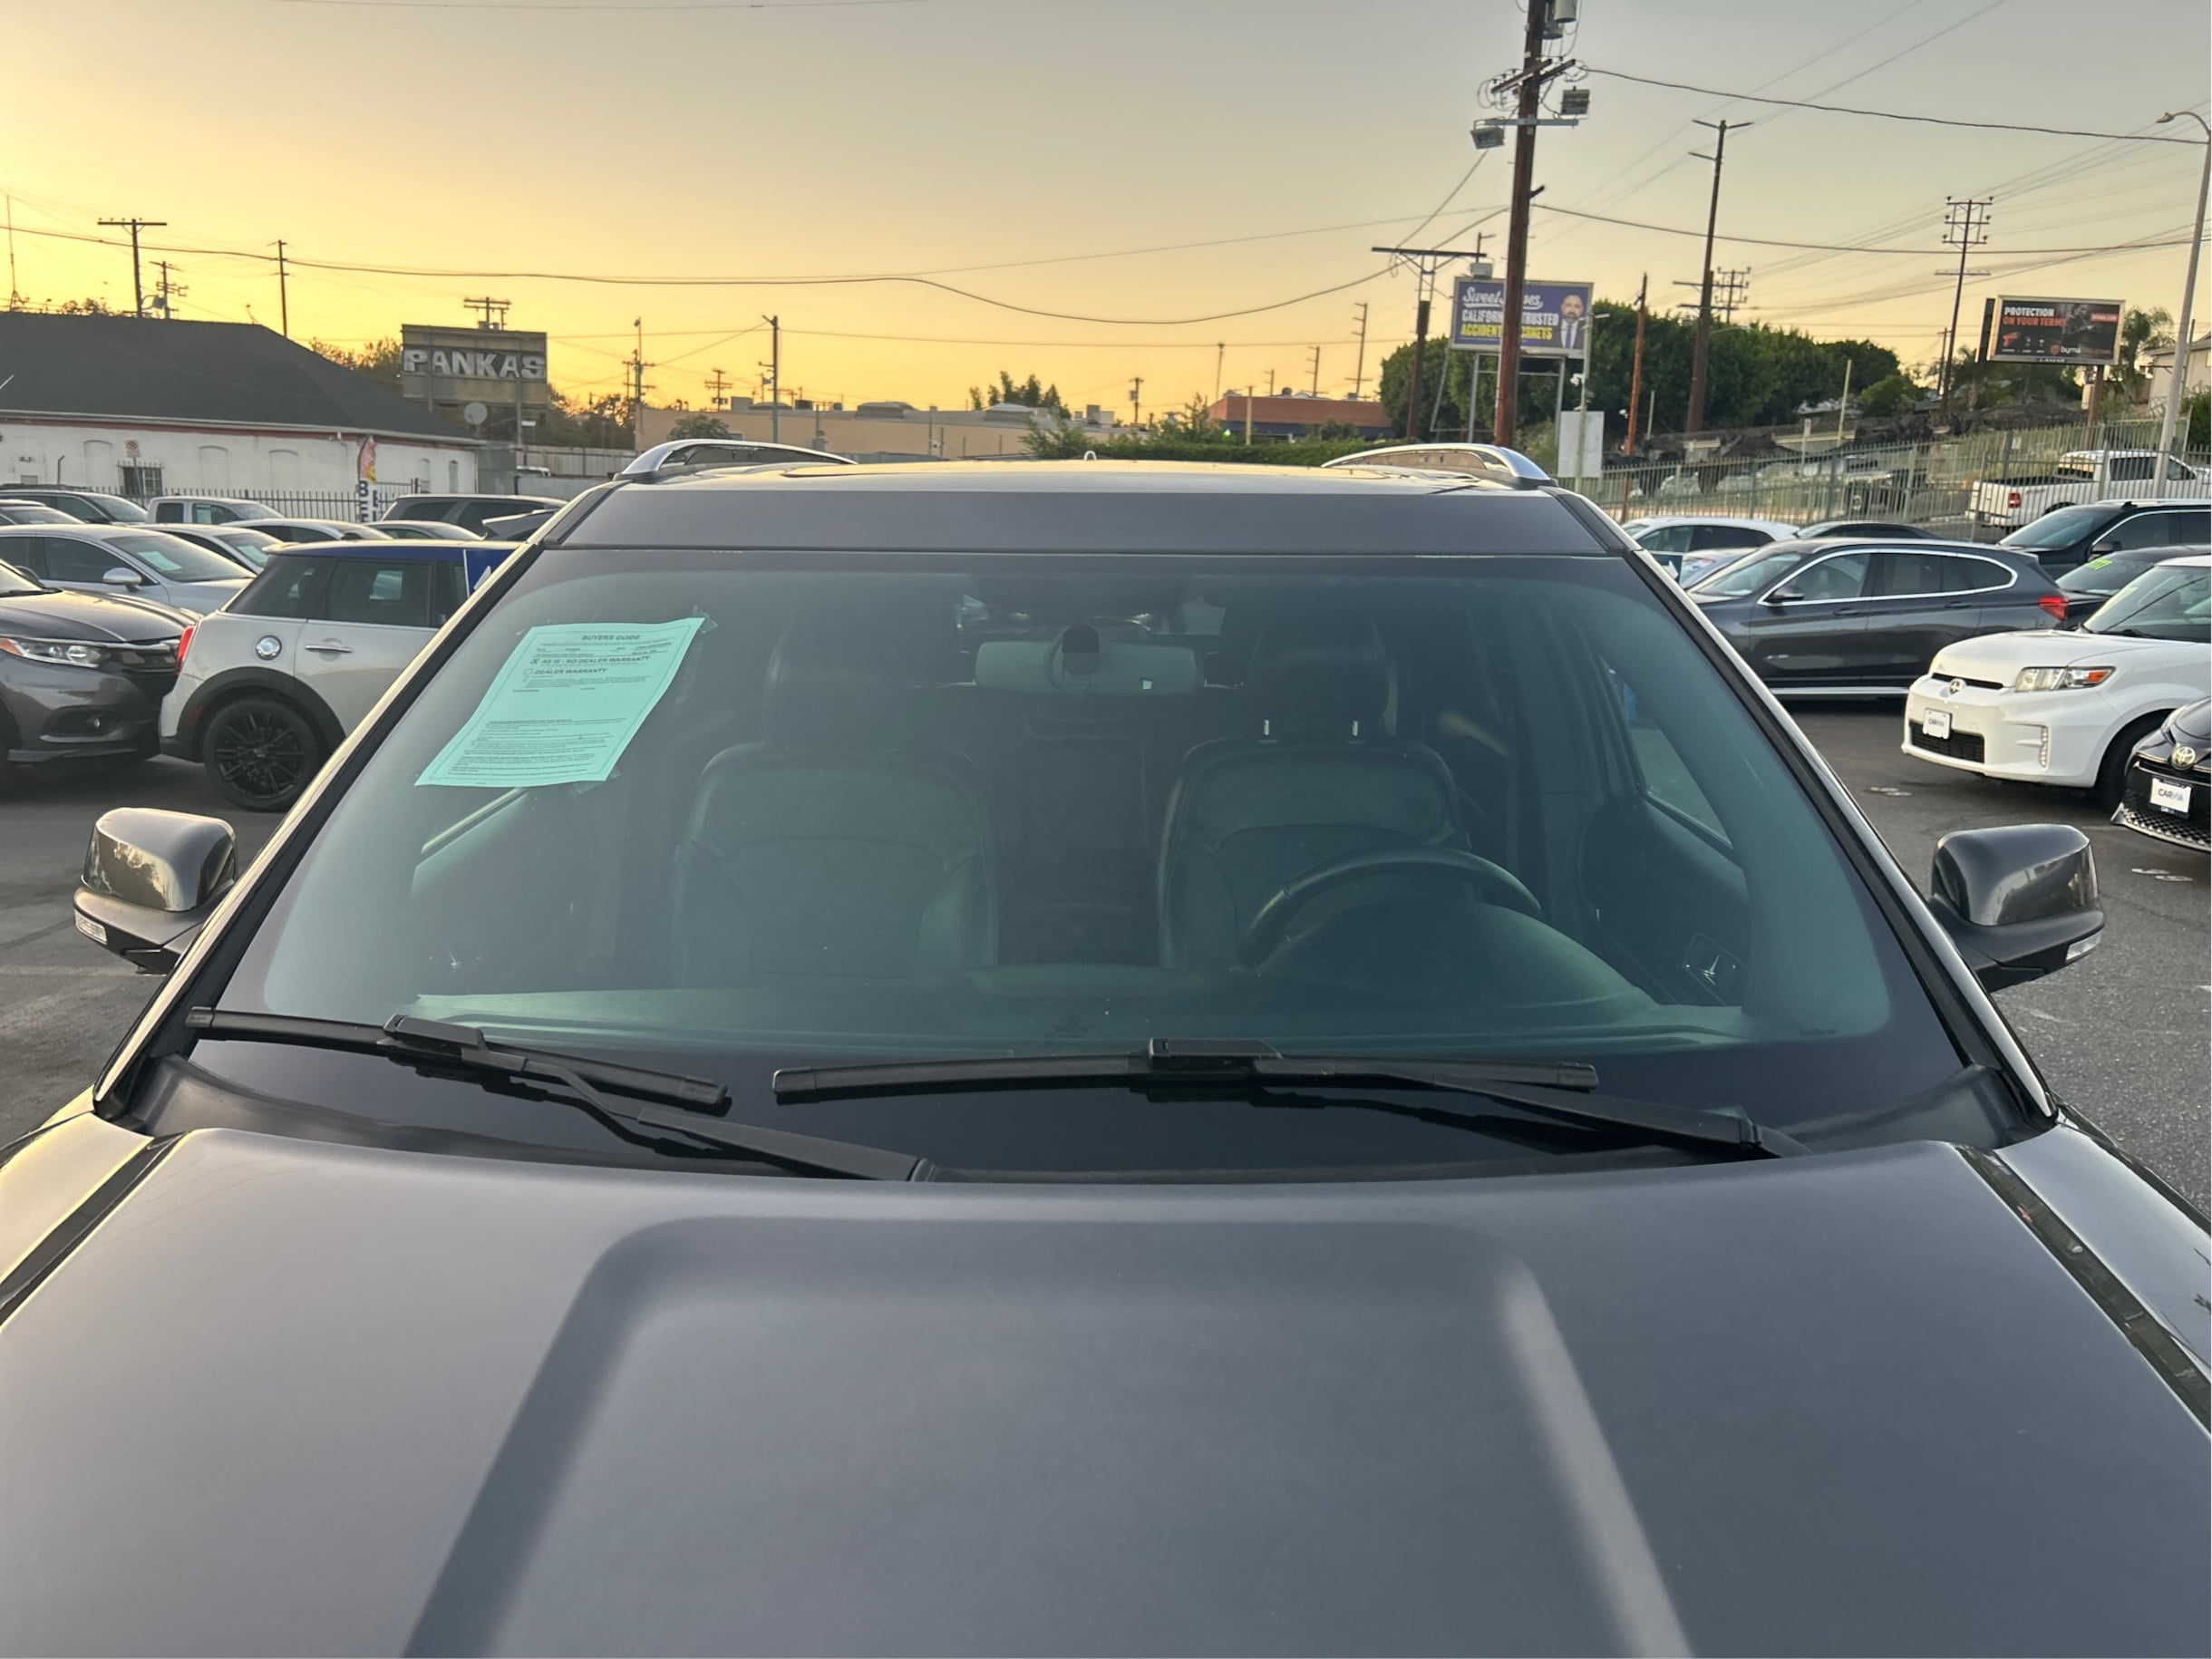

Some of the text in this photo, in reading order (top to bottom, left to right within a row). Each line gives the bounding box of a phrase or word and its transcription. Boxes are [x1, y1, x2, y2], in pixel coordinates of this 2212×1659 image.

[1462, 286, 1501, 303] Sweet
[1461, 309, 1559, 325] CALIFORN TRUSTED
[2004, 306, 2054, 316] PROTECTION
[2017, 317, 2038, 325] YOUR
[2060, 345, 2081, 354] byrna
[403, 349, 546, 380] PANKAS
